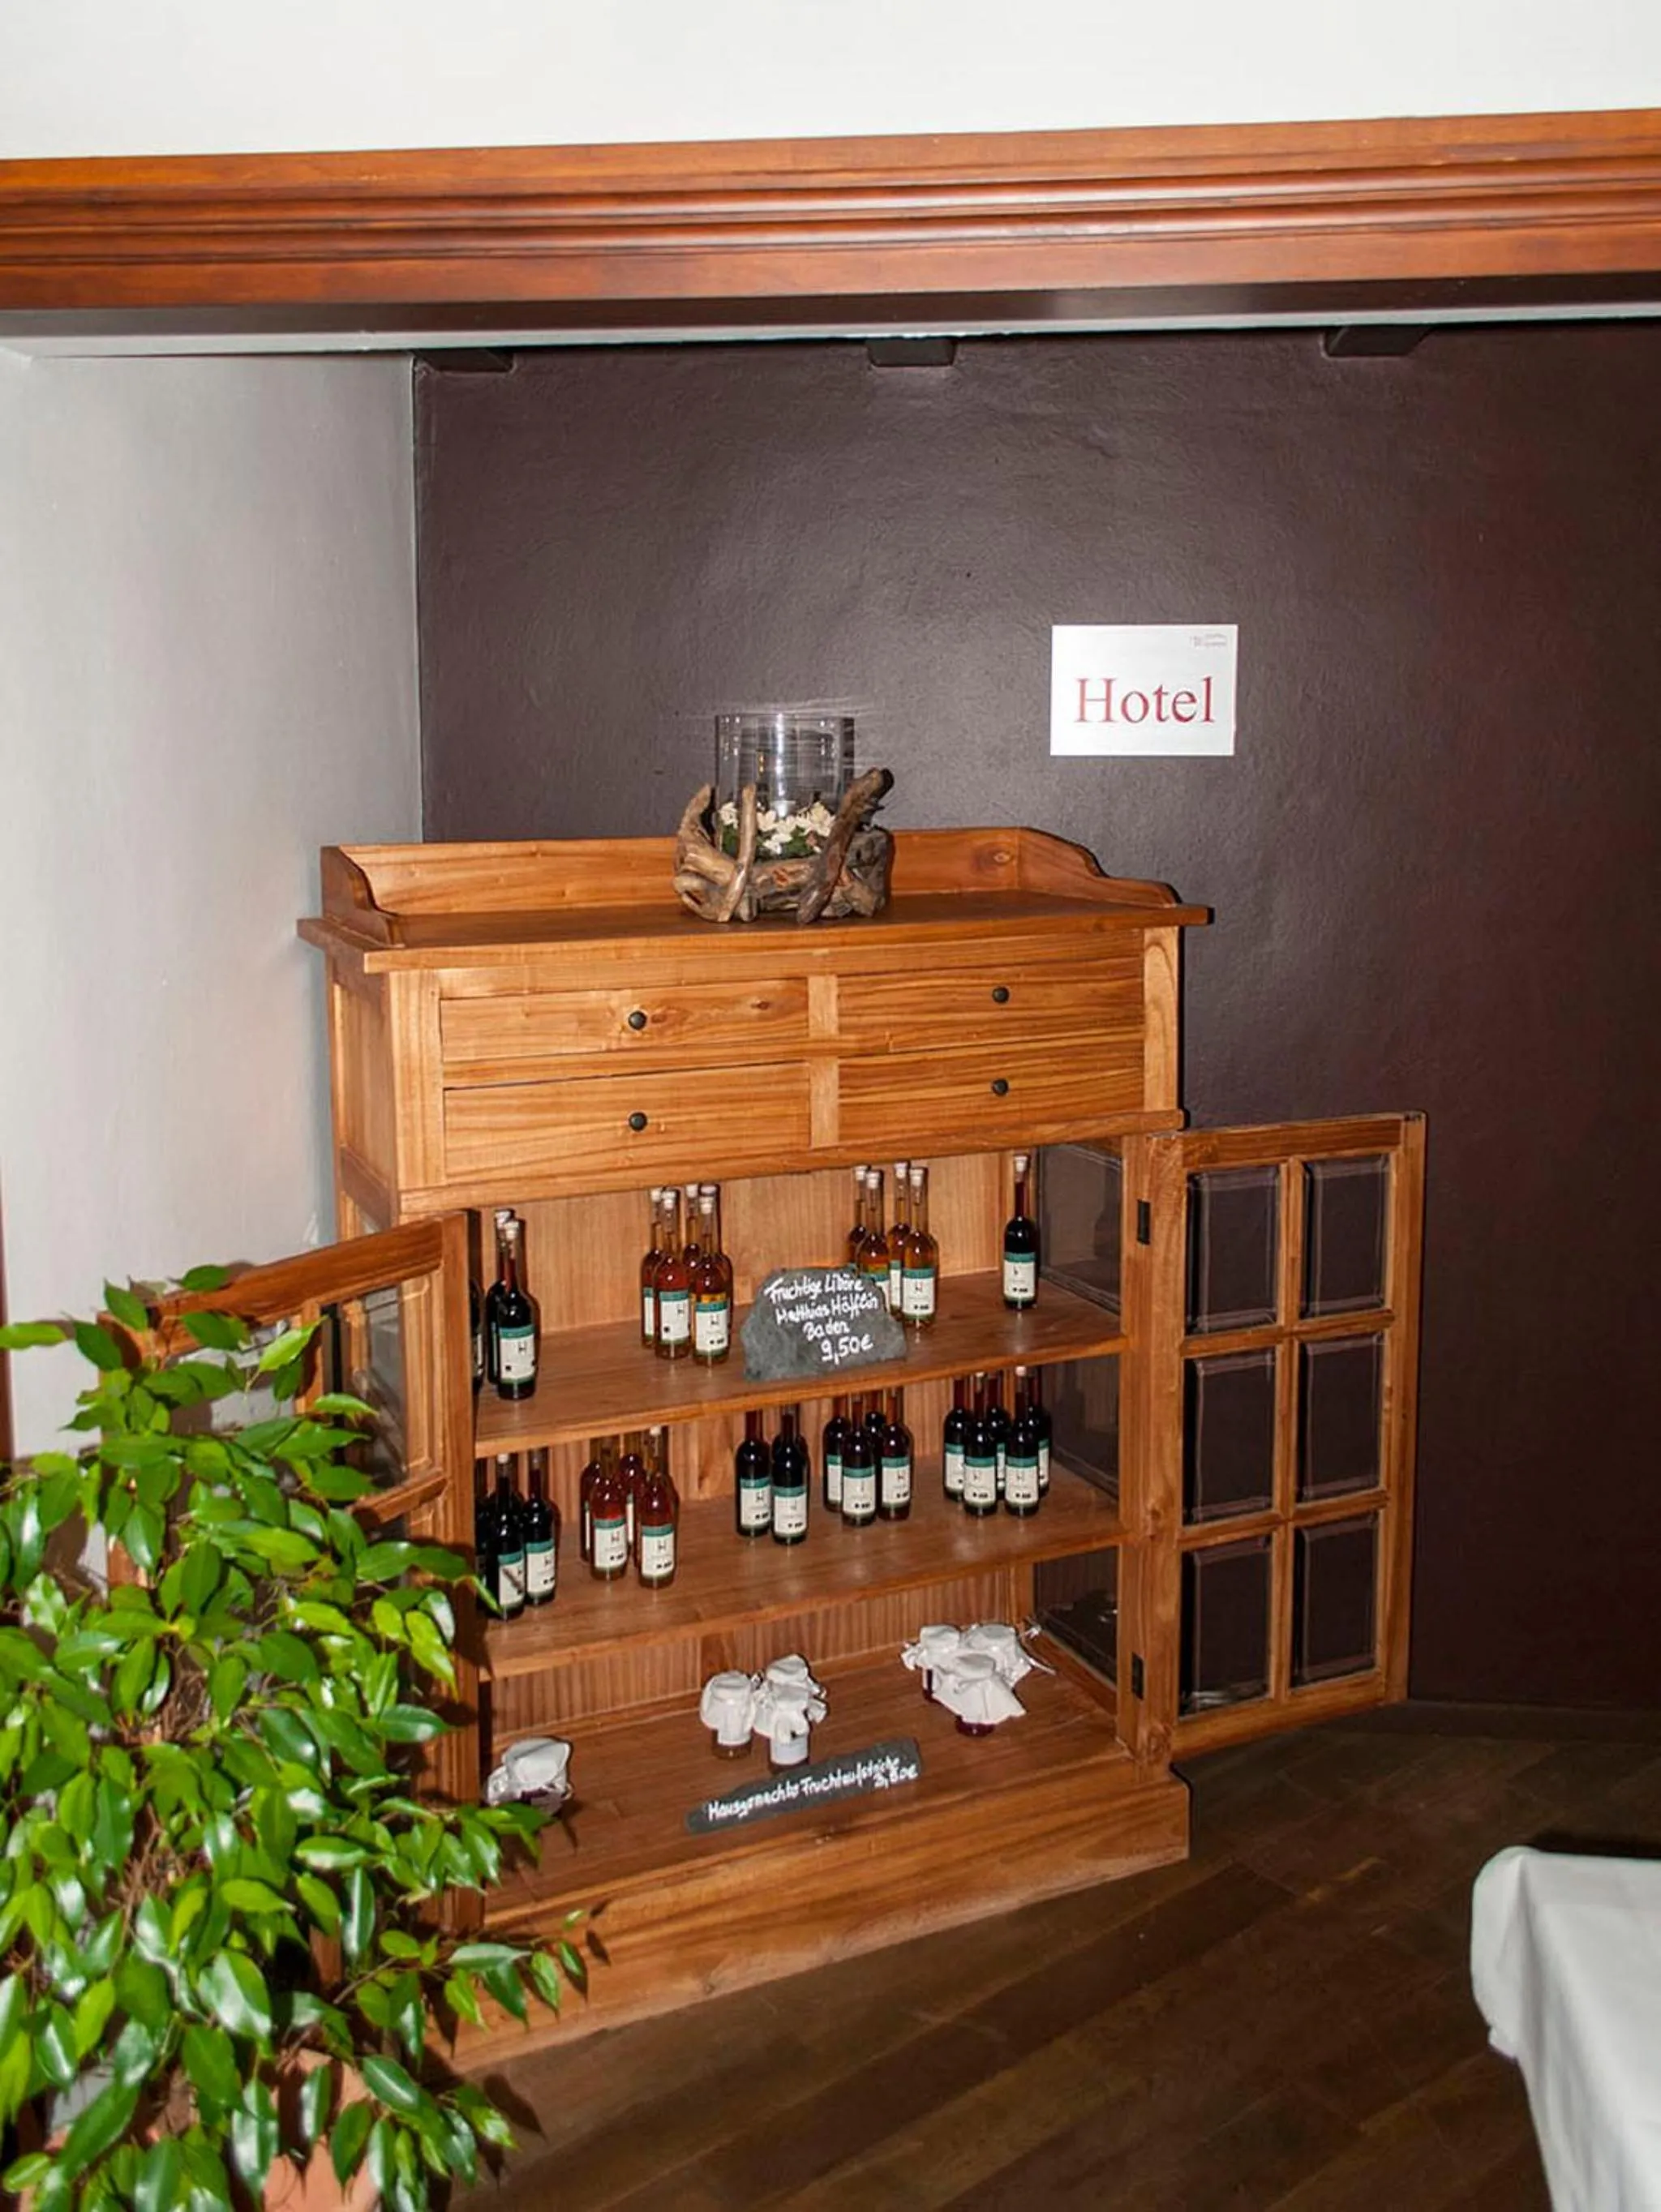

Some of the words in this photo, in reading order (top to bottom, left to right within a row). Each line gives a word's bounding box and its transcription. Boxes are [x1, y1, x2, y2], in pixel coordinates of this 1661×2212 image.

[1074, 676, 1215, 723] Hotel
[803, 1318, 850, 1340] Baden
[822, 1335, 873, 1364] 9,50€
